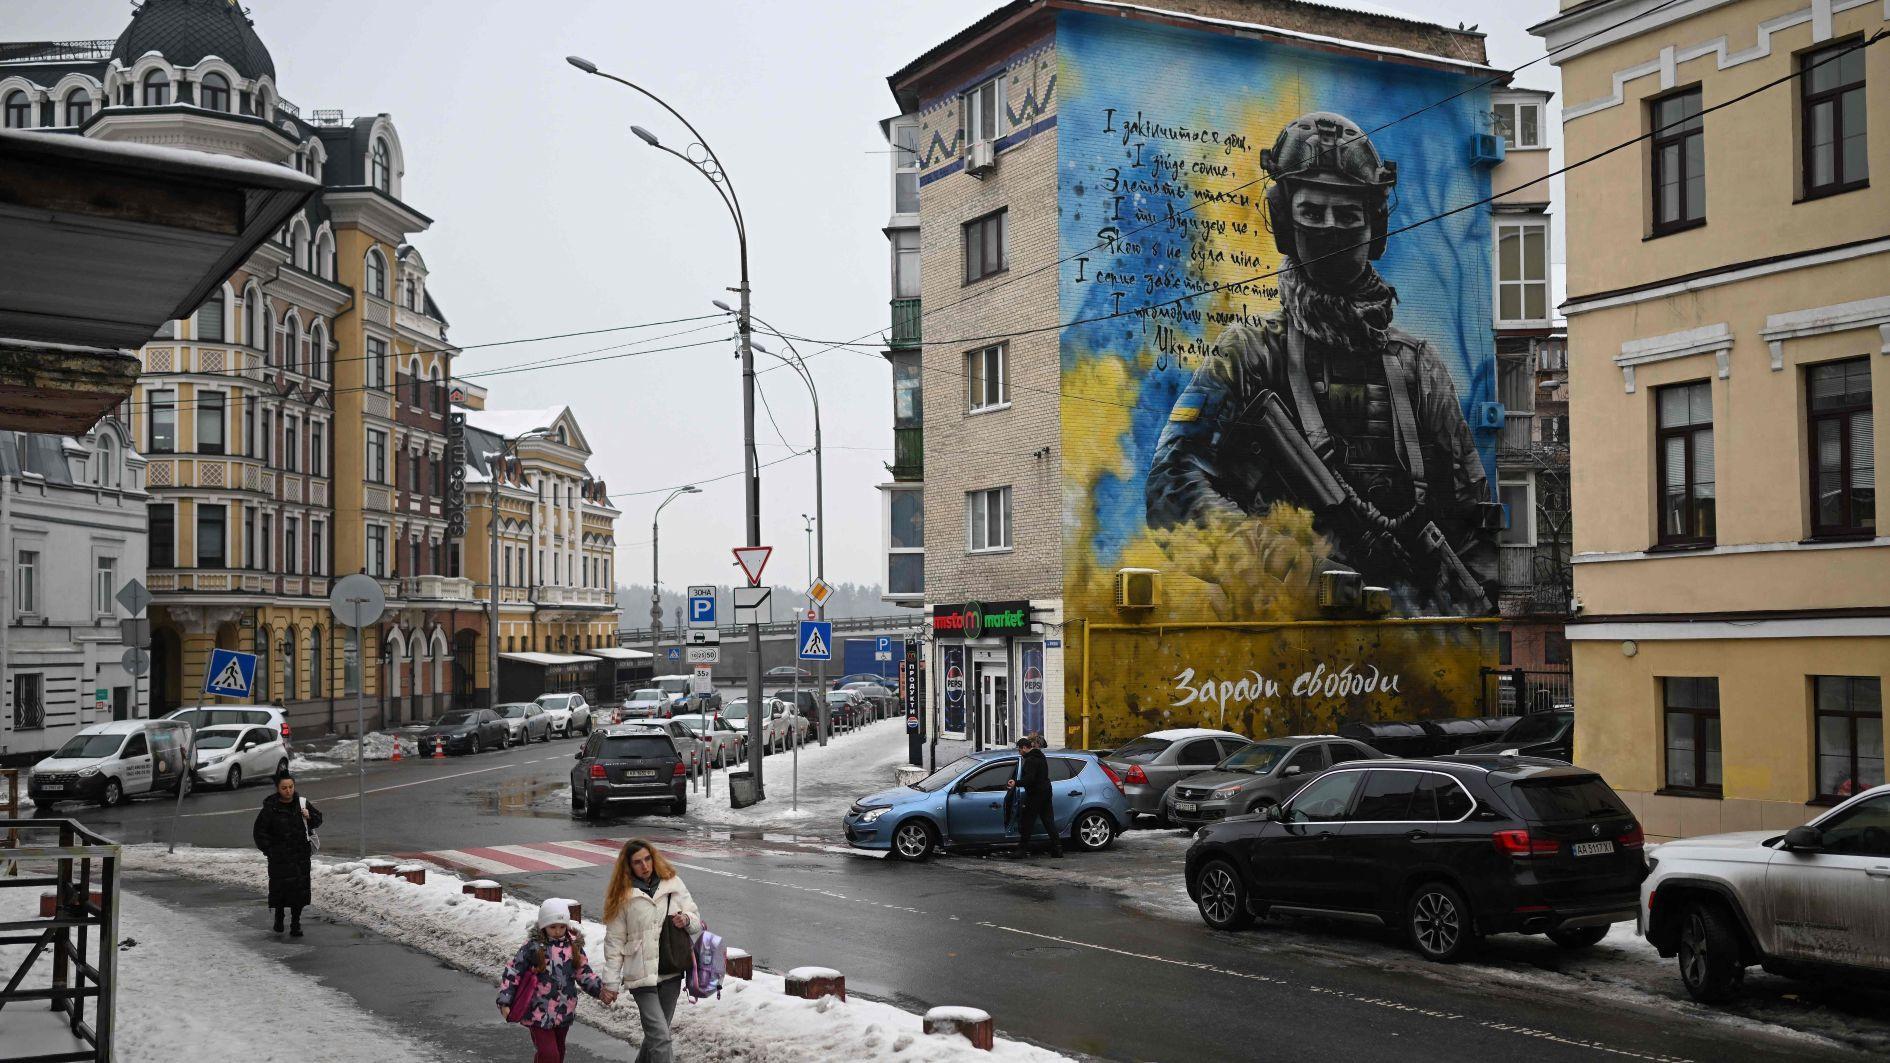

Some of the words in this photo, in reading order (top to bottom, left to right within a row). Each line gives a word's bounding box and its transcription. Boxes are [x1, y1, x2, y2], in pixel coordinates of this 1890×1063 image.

[693, 589, 711, 597] ЗОНА
[984, 609, 1025, 629] market
[908, 663, 916, 715] ПРОДУКТИ
[947, 679, 963, 688] PEPSI
[1024, 681, 1042, 690] PEPSI
[1169, 667, 1281, 728] Заради
[1291, 661, 1401, 698] свободи
